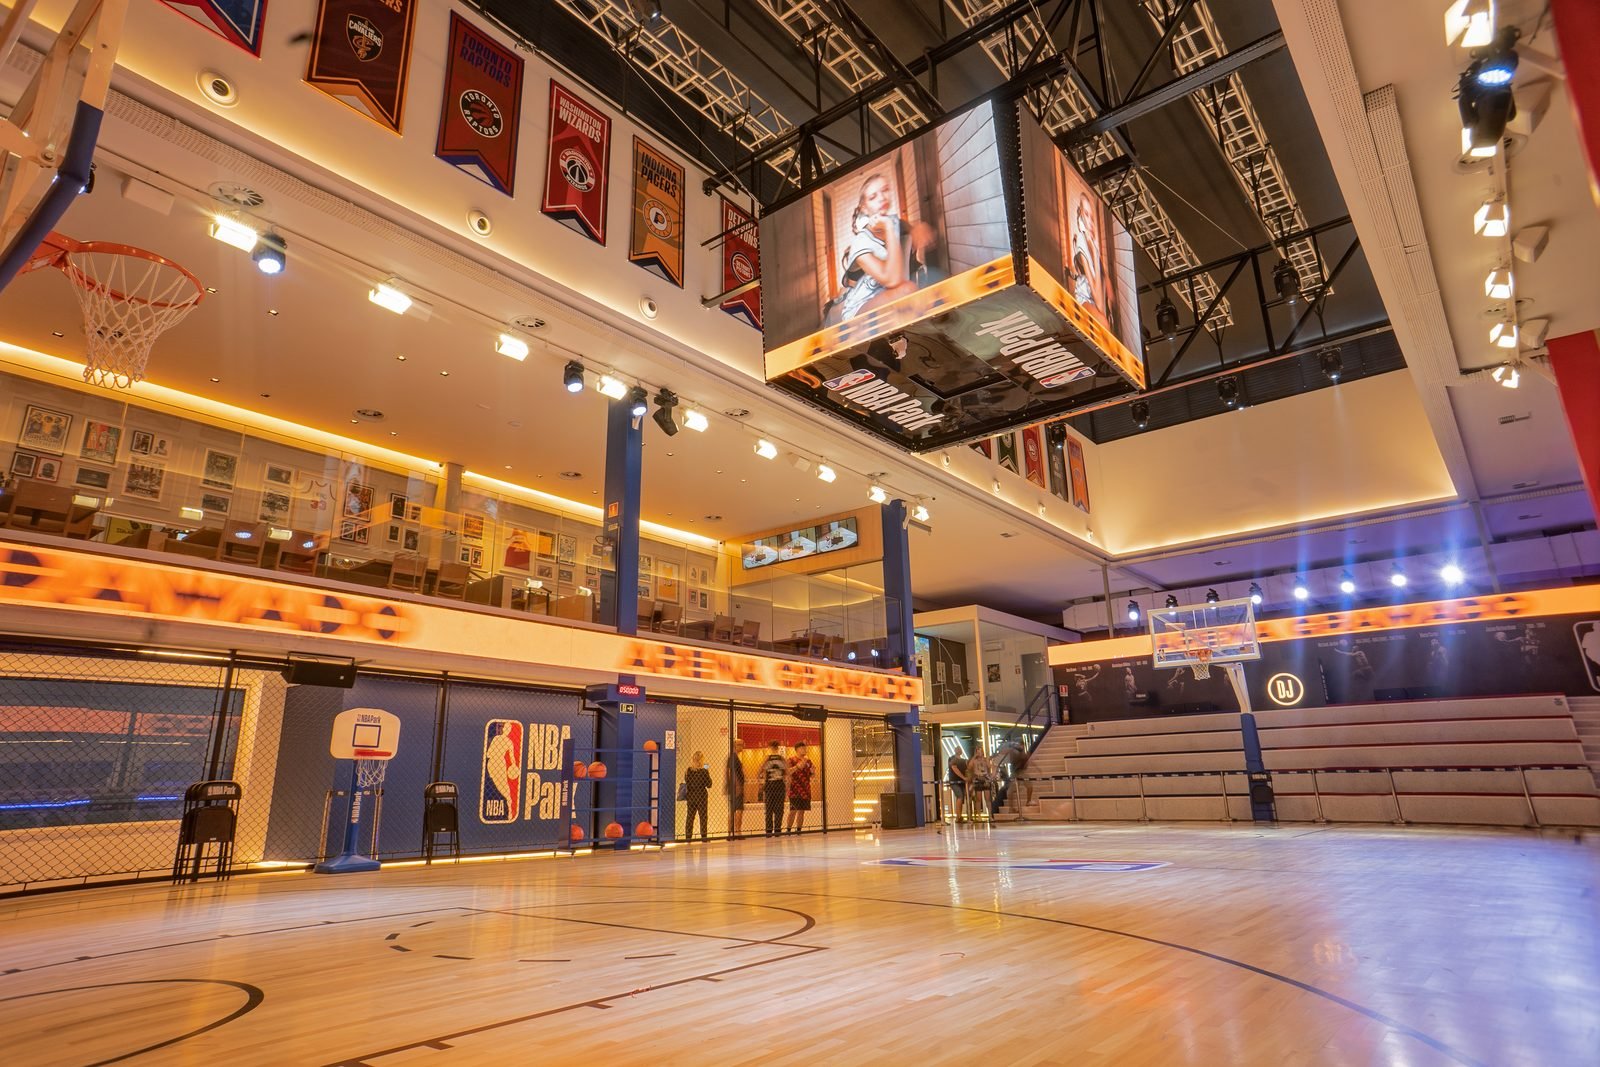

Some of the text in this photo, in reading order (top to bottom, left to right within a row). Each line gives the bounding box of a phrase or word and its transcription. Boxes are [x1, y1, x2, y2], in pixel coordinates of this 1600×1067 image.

[349, 20, 381, 46] CAVALIERS
[460, 46, 511, 88] RAPTORS
[463, 32, 512, 74] TORONTO
[464, 93, 500, 119] TORONTO
[464, 109, 499, 135] RAPTORS
[560, 96, 602, 130] WASHINGTON
[559, 106, 601, 143] WIZARDS
[641, 151, 677, 184] INDIANA
[641, 165, 677, 198] PACERS
[975, 310, 1085, 380] NBA Park
[840, 379, 945, 431] NBA Park
[1276, 679, 1294, 699] DJ
[486, 800, 505, 817] NBA
